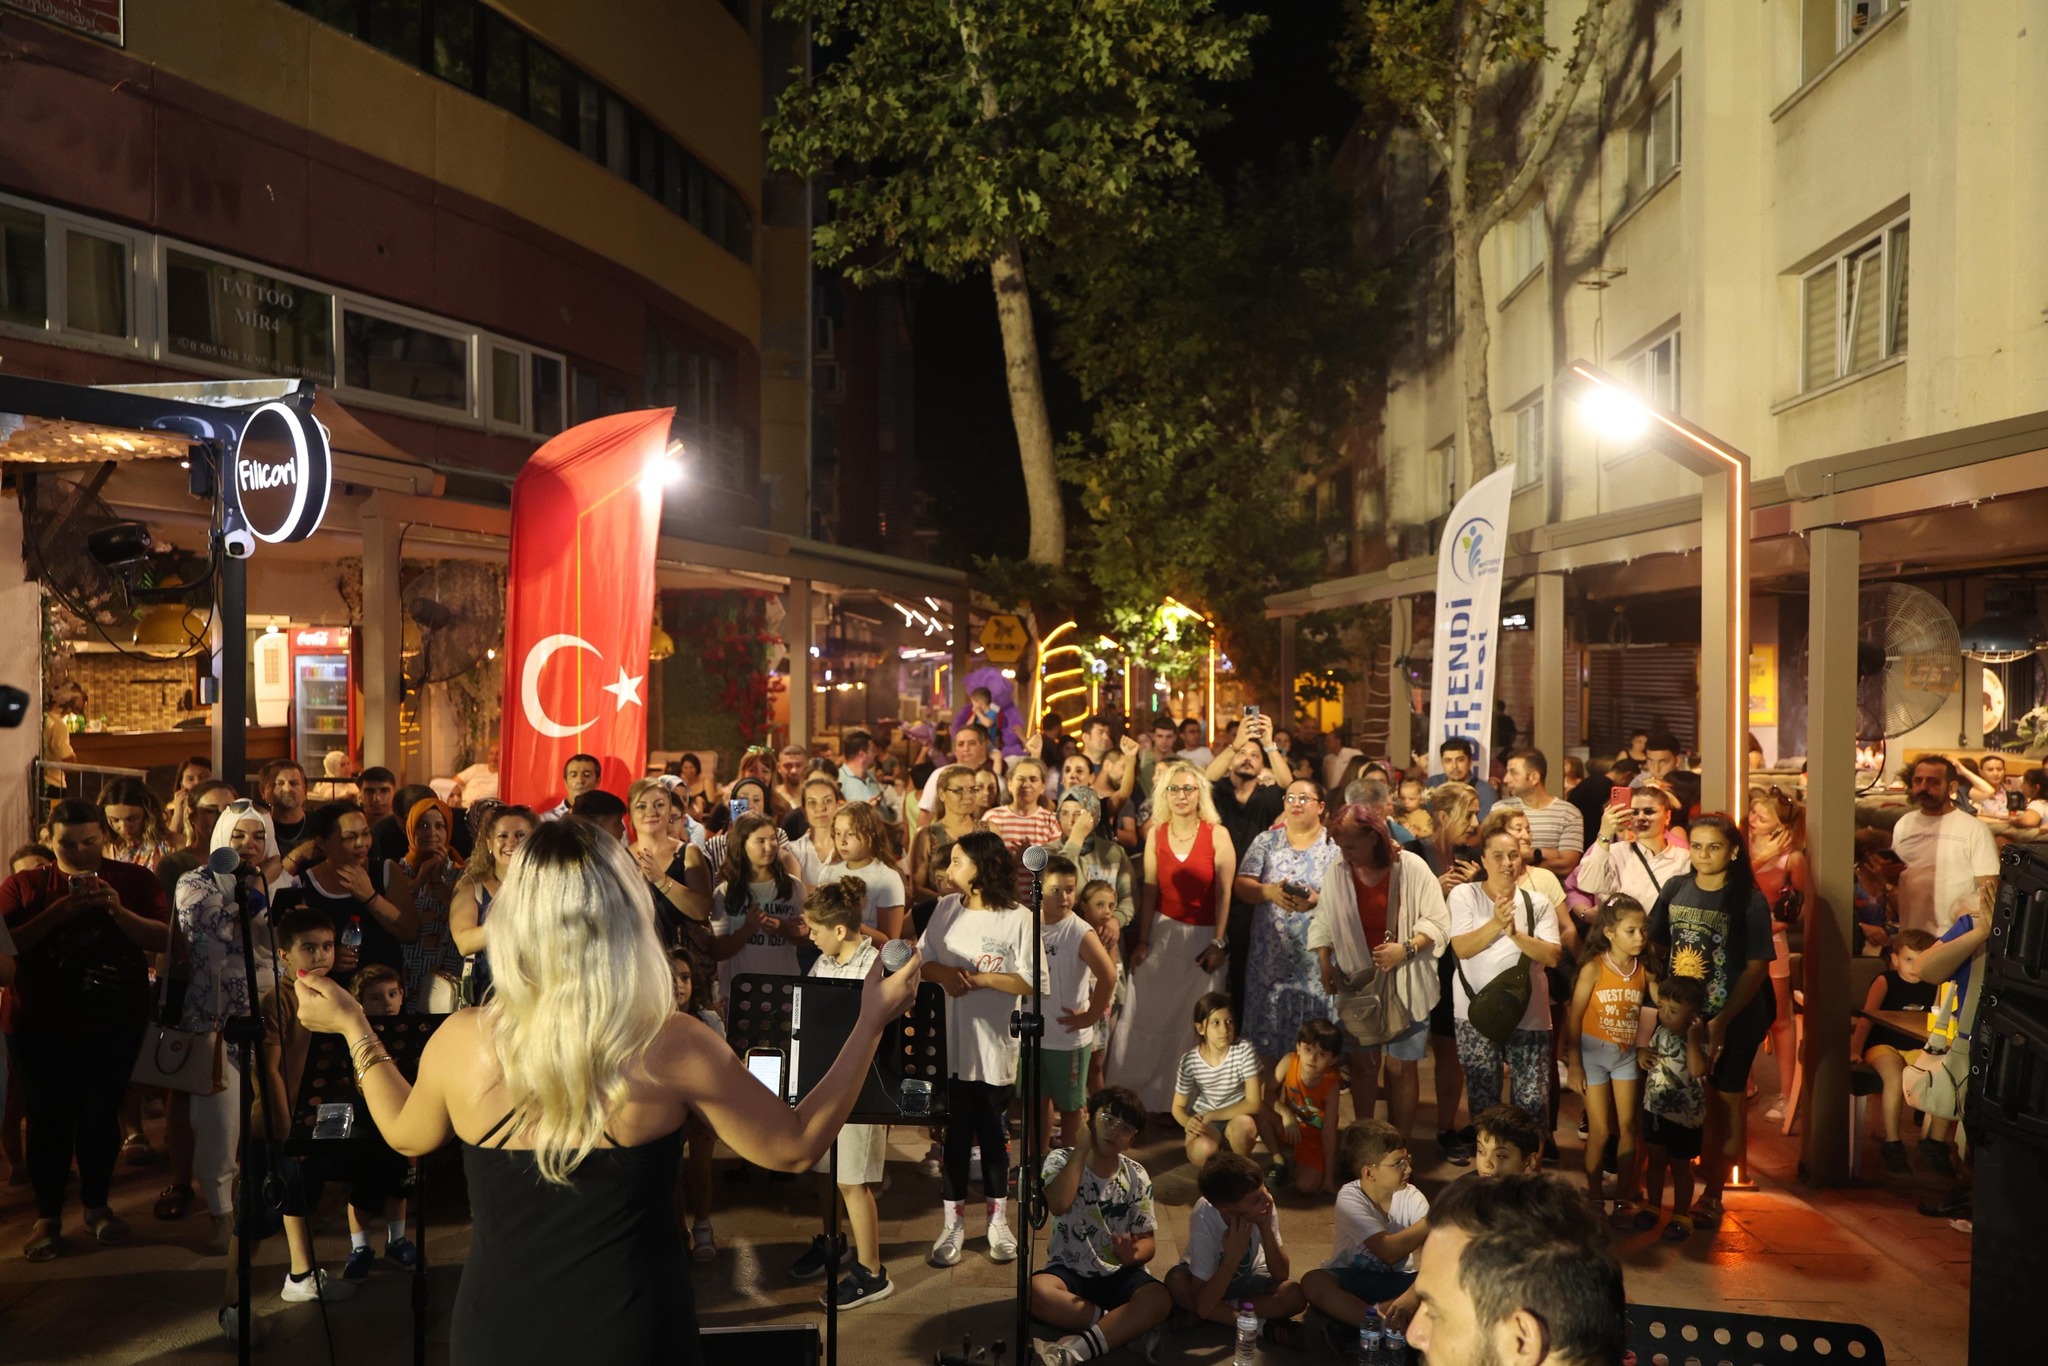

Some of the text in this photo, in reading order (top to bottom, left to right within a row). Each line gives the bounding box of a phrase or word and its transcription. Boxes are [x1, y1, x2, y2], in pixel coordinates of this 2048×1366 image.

[219, 276, 293, 309] TATTOO
[1595, 988, 1623, 1003] WEST
[1599, 1016, 1615, 1027] LOS
